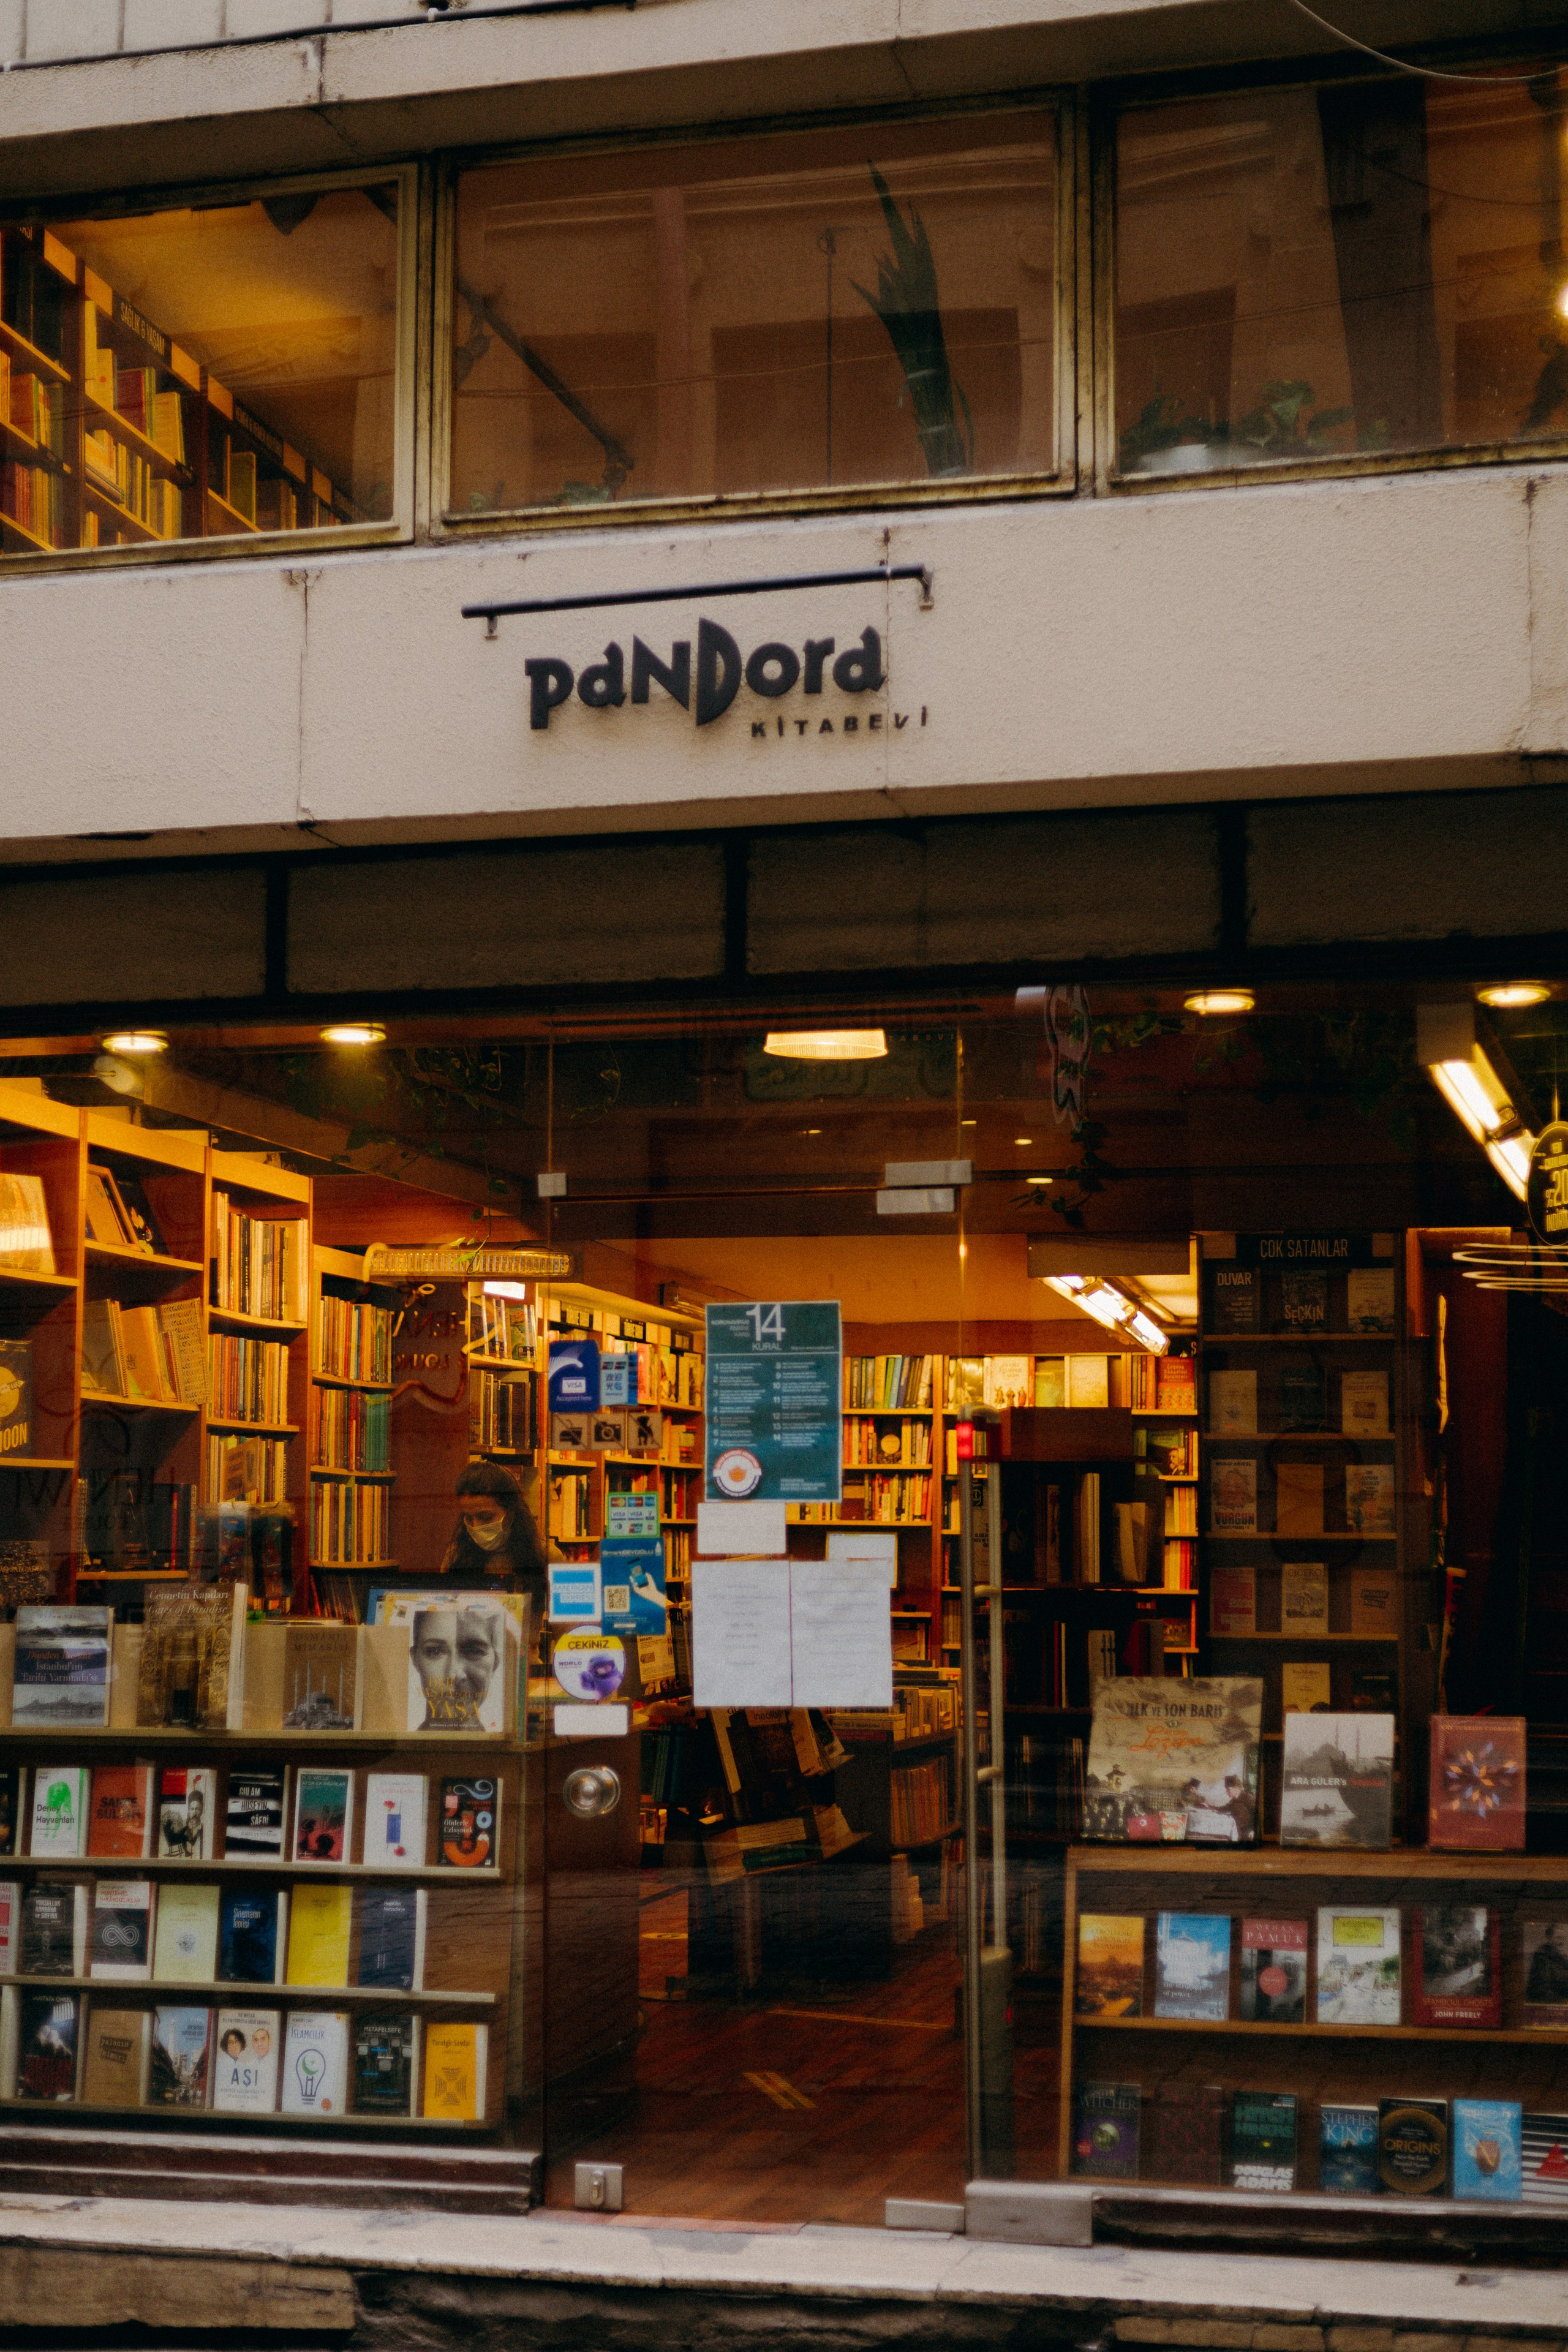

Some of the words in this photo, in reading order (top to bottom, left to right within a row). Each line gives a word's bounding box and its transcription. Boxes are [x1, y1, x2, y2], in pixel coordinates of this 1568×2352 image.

[1260, 1240, 1284, 1261] ÇOK
[1287, 1238, 1348, 1257] SATANLAR
[1217, 1272, 1252, 1286] DUVAR
[746, 1304, 786, 1341] 14
[752, 1342, 783, 1351] KURAL
[552, 1584, 594, 1593] AMERICAN
[560, 1594, 595, 1602] EXPRESS
[187, 1603, 228, 1614] Paradise
[1164, 1703, 1186, 1717] SON
[36, 1804, 61, 1813] Deney
[1246, 1933, 1303, 1945] PAMUK
[231, 2068, 258, 2087] AŞI
[1321, 2111, 1378, 2127] STEPHEN
[1324, 2125, 1374, 2143] KING
[1384, 2139, 1441, 2155] ORIGINS
[1235, 2176, 1293, 2191] ADAMS
